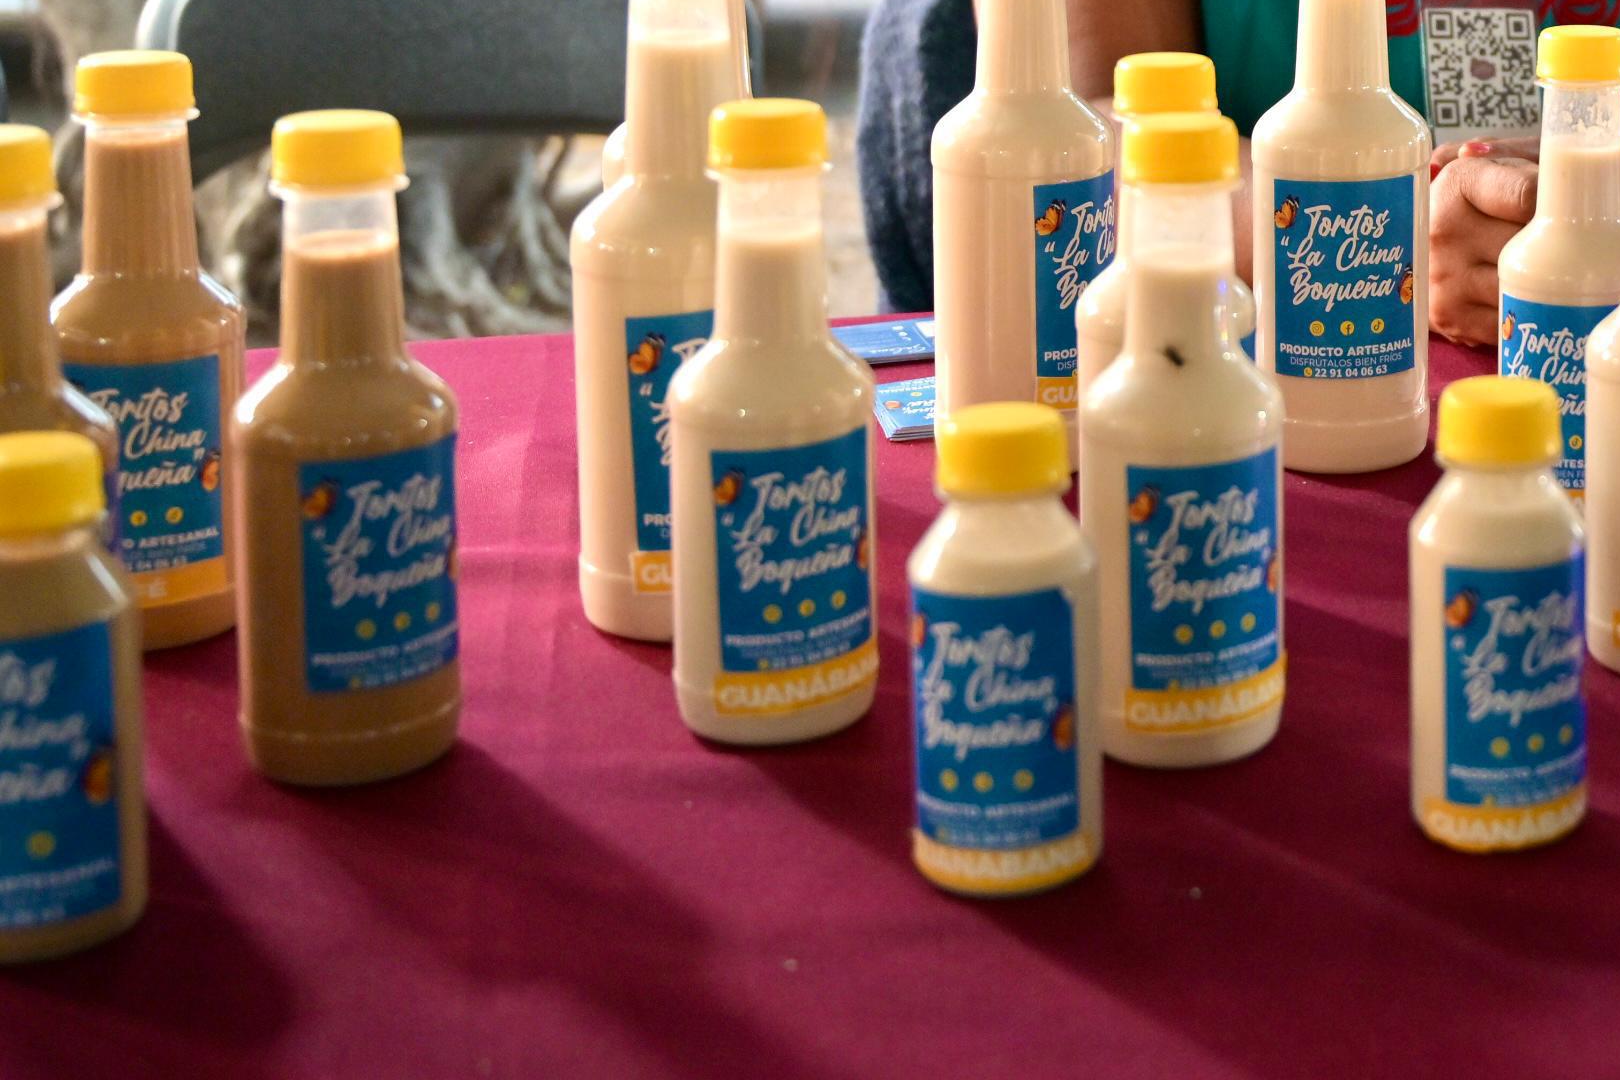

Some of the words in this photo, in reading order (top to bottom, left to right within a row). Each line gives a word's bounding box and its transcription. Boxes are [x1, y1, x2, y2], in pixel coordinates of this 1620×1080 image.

[1304, 205, 1390, 240] Toritos
[1336, 237, 1404, 272] China
[1044, 347, 1077, 362] PROD
[1280, 343, 1343, 356] PRODUCTO
[1347, 337, 1412, 356] ARTESANAL
[1290, 356, 1353, 367] DISFRÚTALOS
[1355, 357, 1377, 367] BIEN
[1379, 351, 1402, 363] FRÍOS
[1315, 368, 1327, 378] 22
[1330, 368, 1342, 378] 91
[1346, 368, 1358, 377] 04
[1361, 366, 1373, 376] 06
[1376, 364, 1387, 374] 63
[1540, 356, 1587, 386] Chin
[124, 422, 207, 460] China
